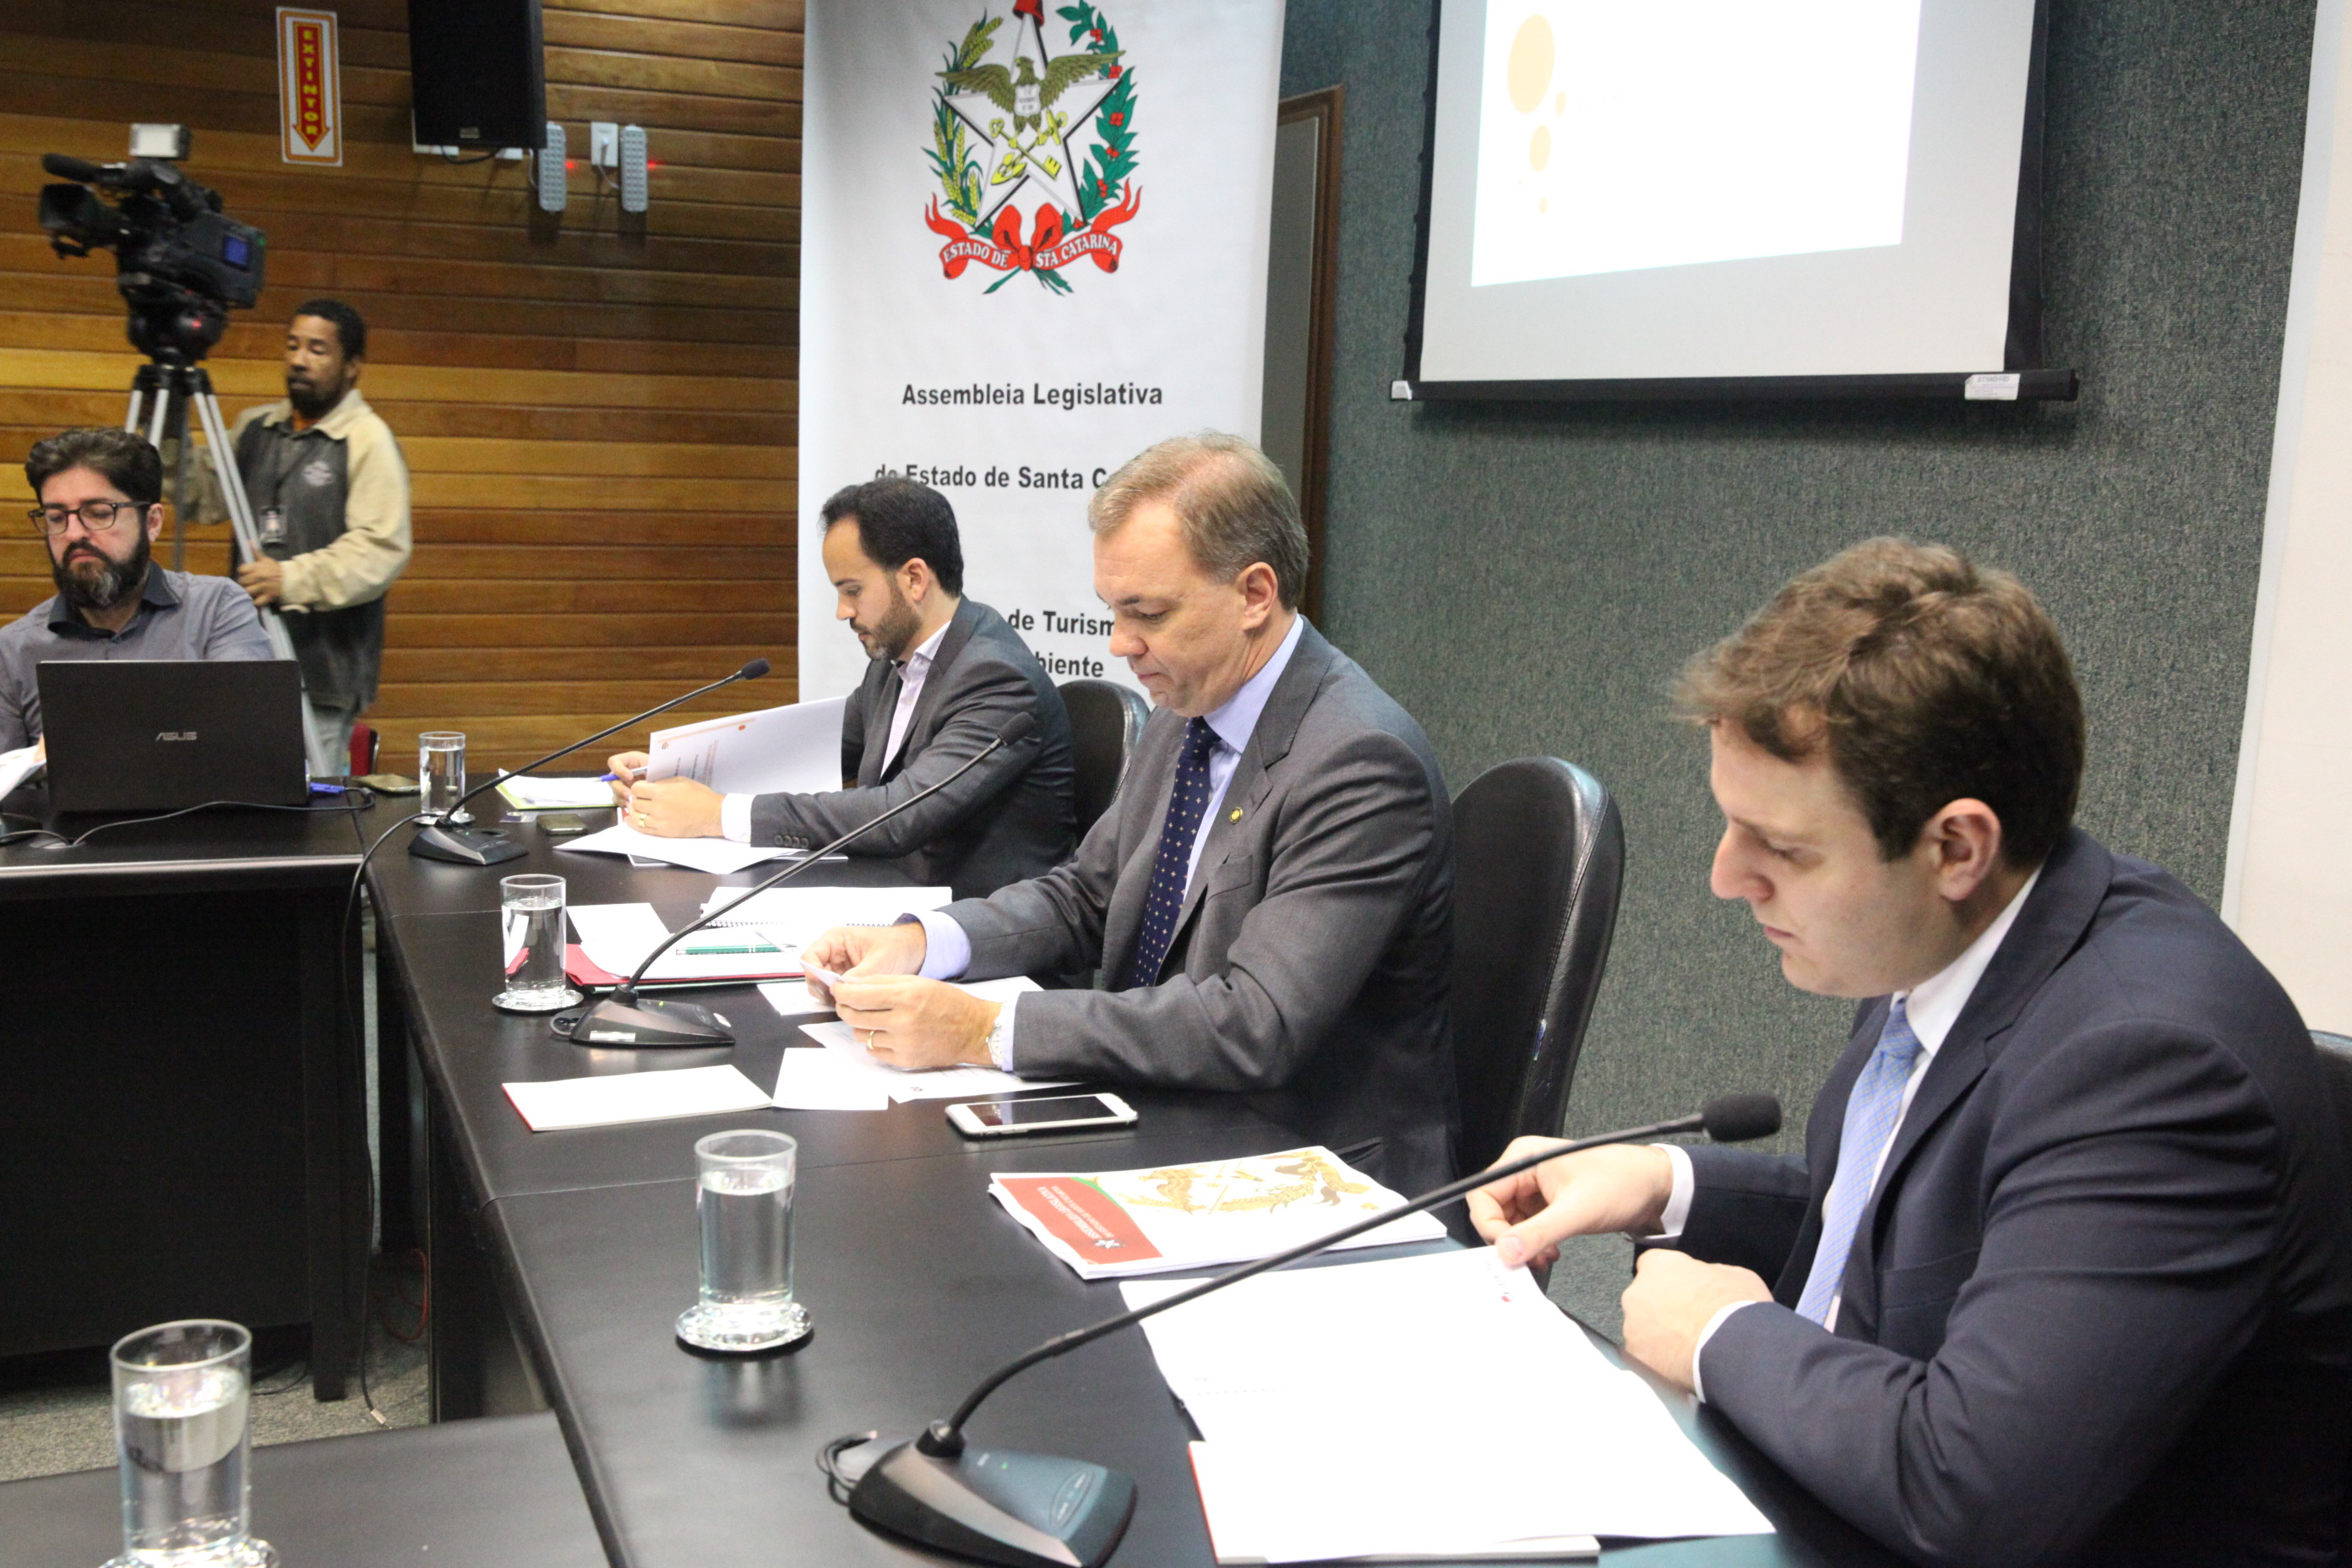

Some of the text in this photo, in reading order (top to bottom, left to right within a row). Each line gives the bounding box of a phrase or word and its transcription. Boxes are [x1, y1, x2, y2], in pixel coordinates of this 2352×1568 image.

[302, 30, 318, 135] EXTINTOR
[943, 242, 990, 263] ESTADO
[991, 250, 1008, 268] DE
[1061, 234, 1118, 260] CATARINA
[902, 383, 1162, 411] Assembleia Legislativa
[906, 465, 977, 487] Estado
[984, 466, 1010, 487] de
[1018, 466, 1083, 489] Santa
[1008, 609, 1034, 630] de
[155, 732, 197, 741] ASUS
